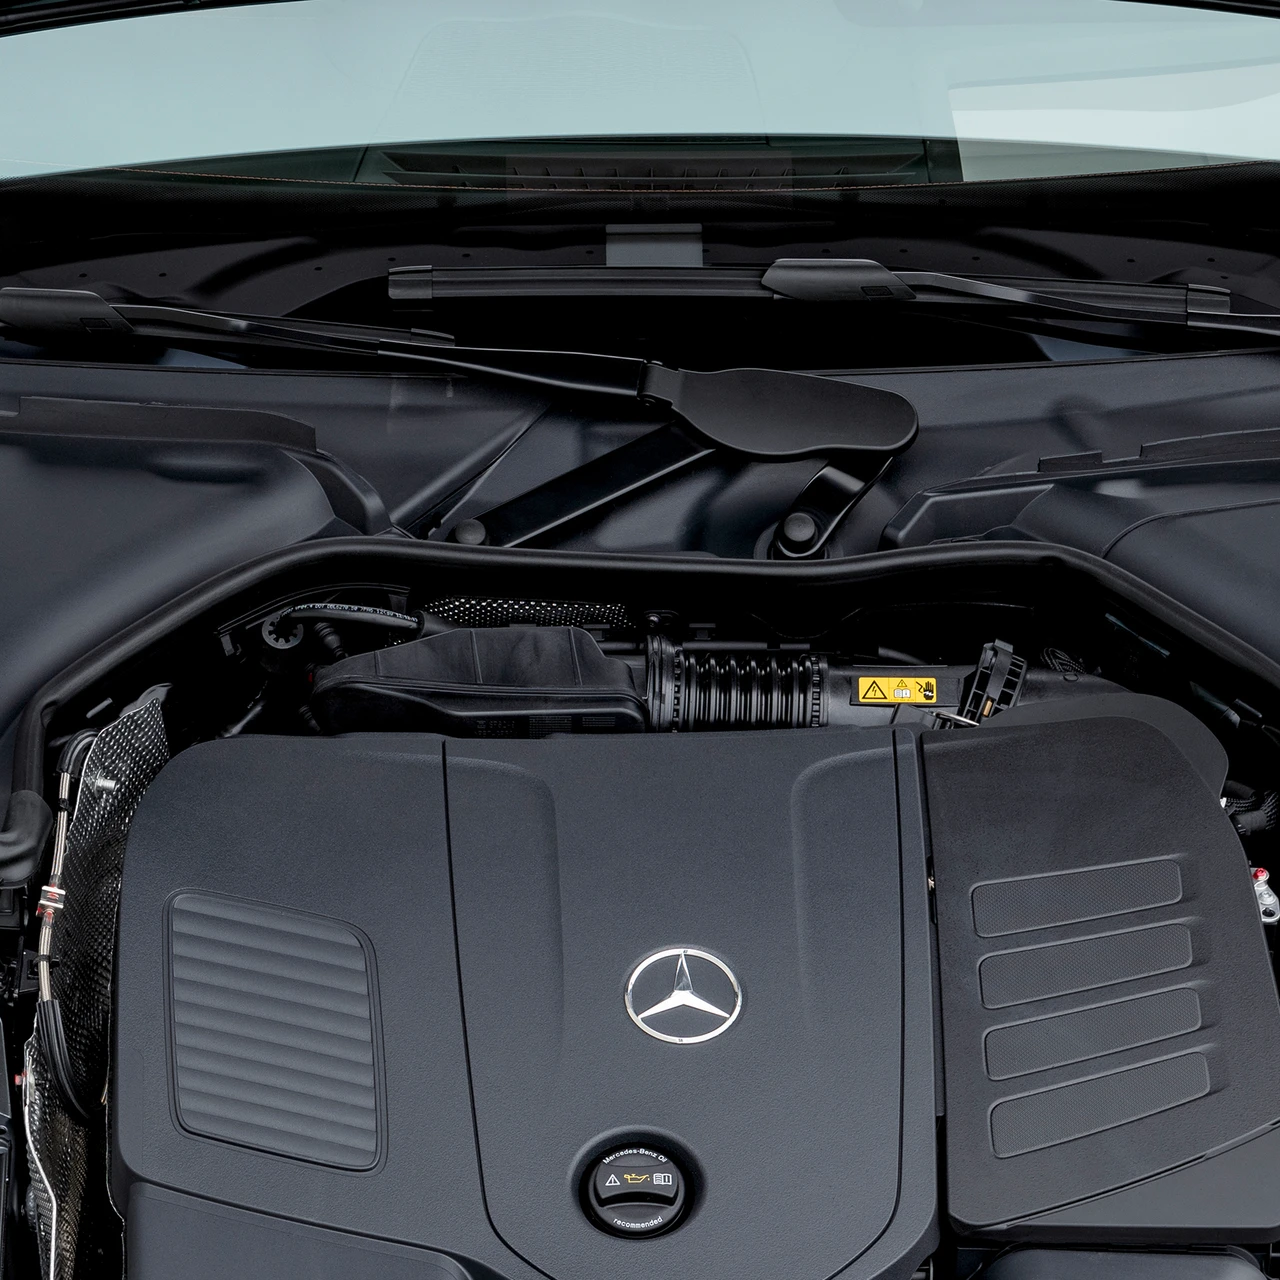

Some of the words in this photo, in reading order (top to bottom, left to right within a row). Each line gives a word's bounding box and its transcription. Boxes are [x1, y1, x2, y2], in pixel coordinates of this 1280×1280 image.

[602, 1148, 658, 1165] Mercedes-Benz
[658, 1155, 668, 1163] Oil
[613, 1216, 663, 1229] recommended
